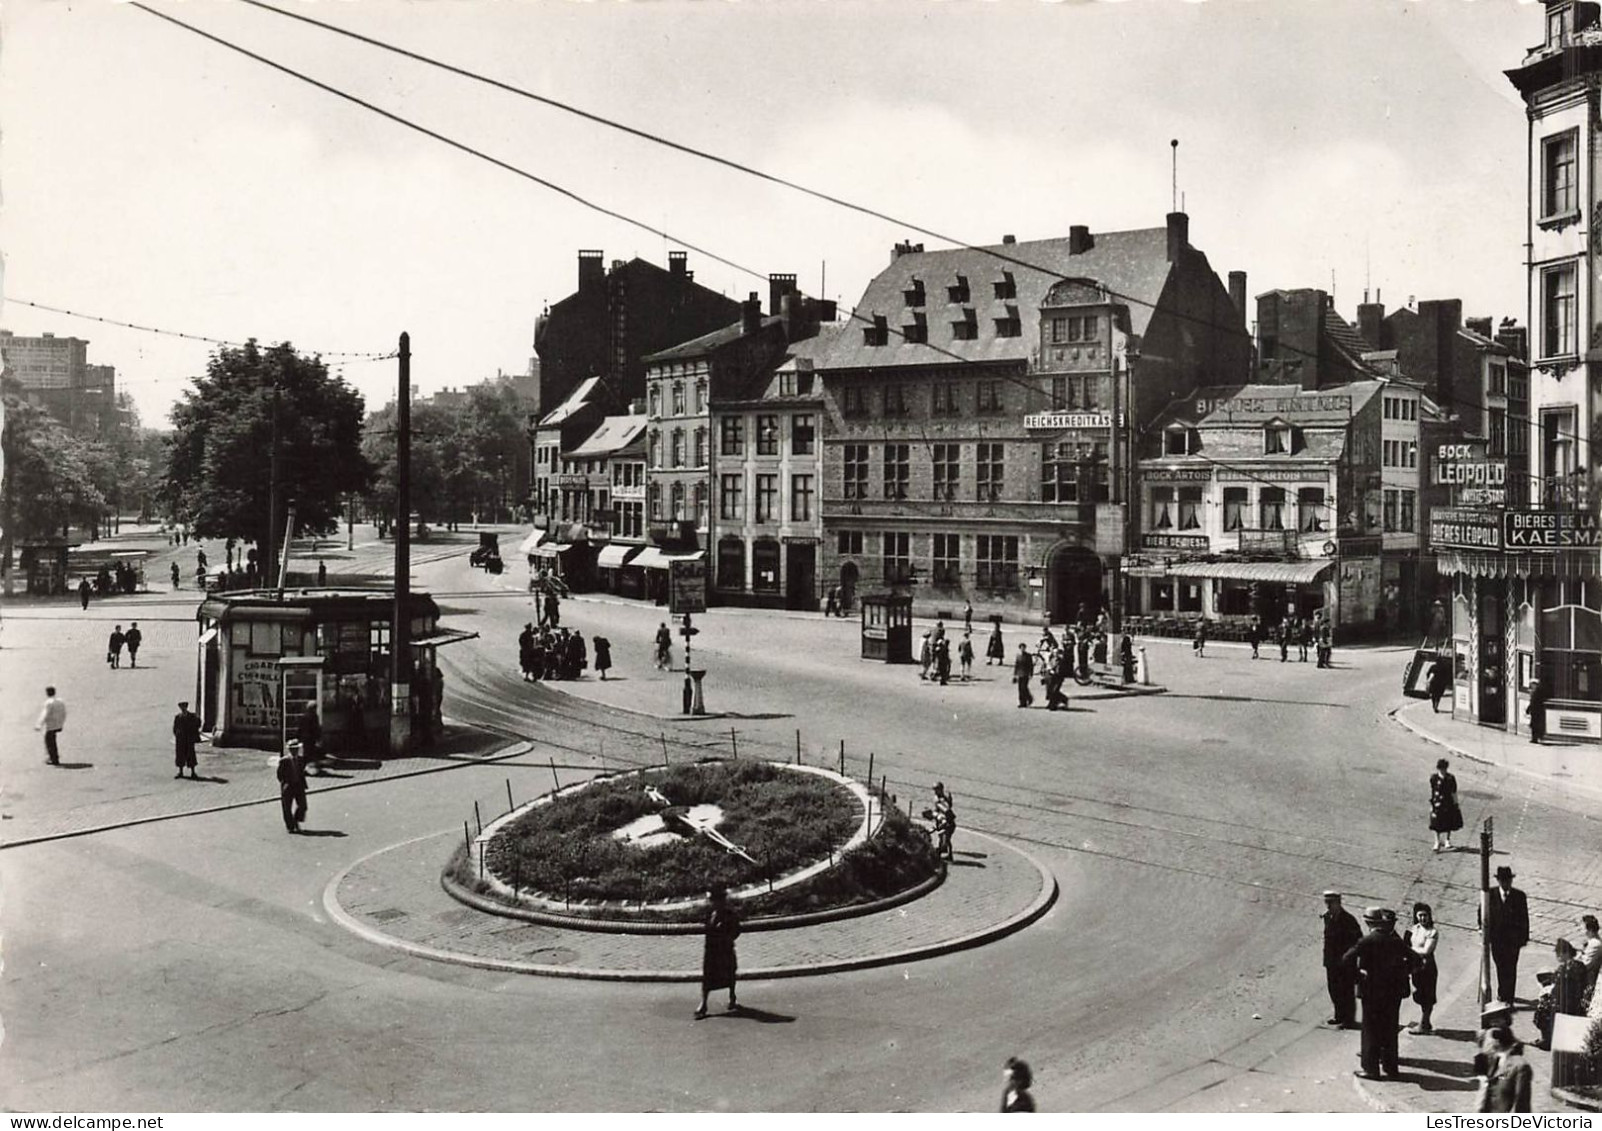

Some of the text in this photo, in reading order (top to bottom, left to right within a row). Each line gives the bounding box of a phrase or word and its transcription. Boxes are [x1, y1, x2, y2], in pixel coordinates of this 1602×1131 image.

[1025, 414, 1123, 428] REICHSKREDITKASE
[1438, 444, 1472, 459] BOCK
[1175, 470, 1210, 480] ARTOIS
[1438, 463, 1506, 485] LEOPOLD
[1560, 514, 1576, 529] DE
[1580, 515, 1595, 529] LA
[1461, 525, 1498, 546] LEOPOLD
